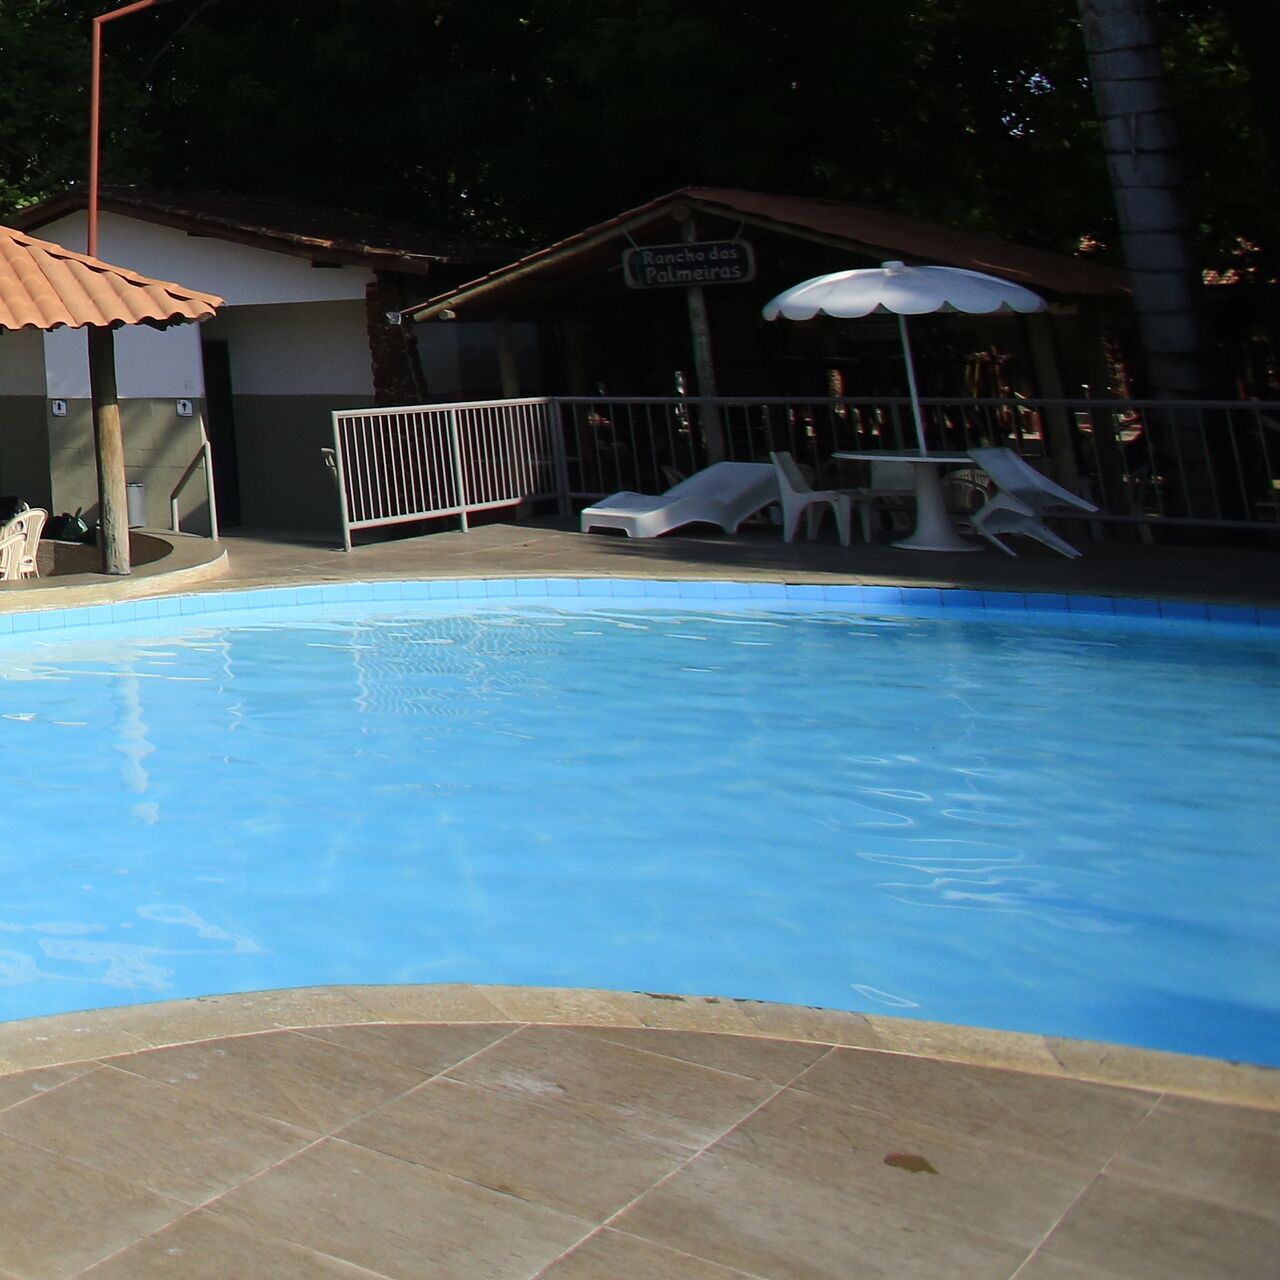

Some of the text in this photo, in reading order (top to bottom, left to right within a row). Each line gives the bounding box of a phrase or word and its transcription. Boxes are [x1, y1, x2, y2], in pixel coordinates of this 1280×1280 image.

[642, 245, 739, 265] Rancho das
[645, 265, 742, 284] Palmeiras
